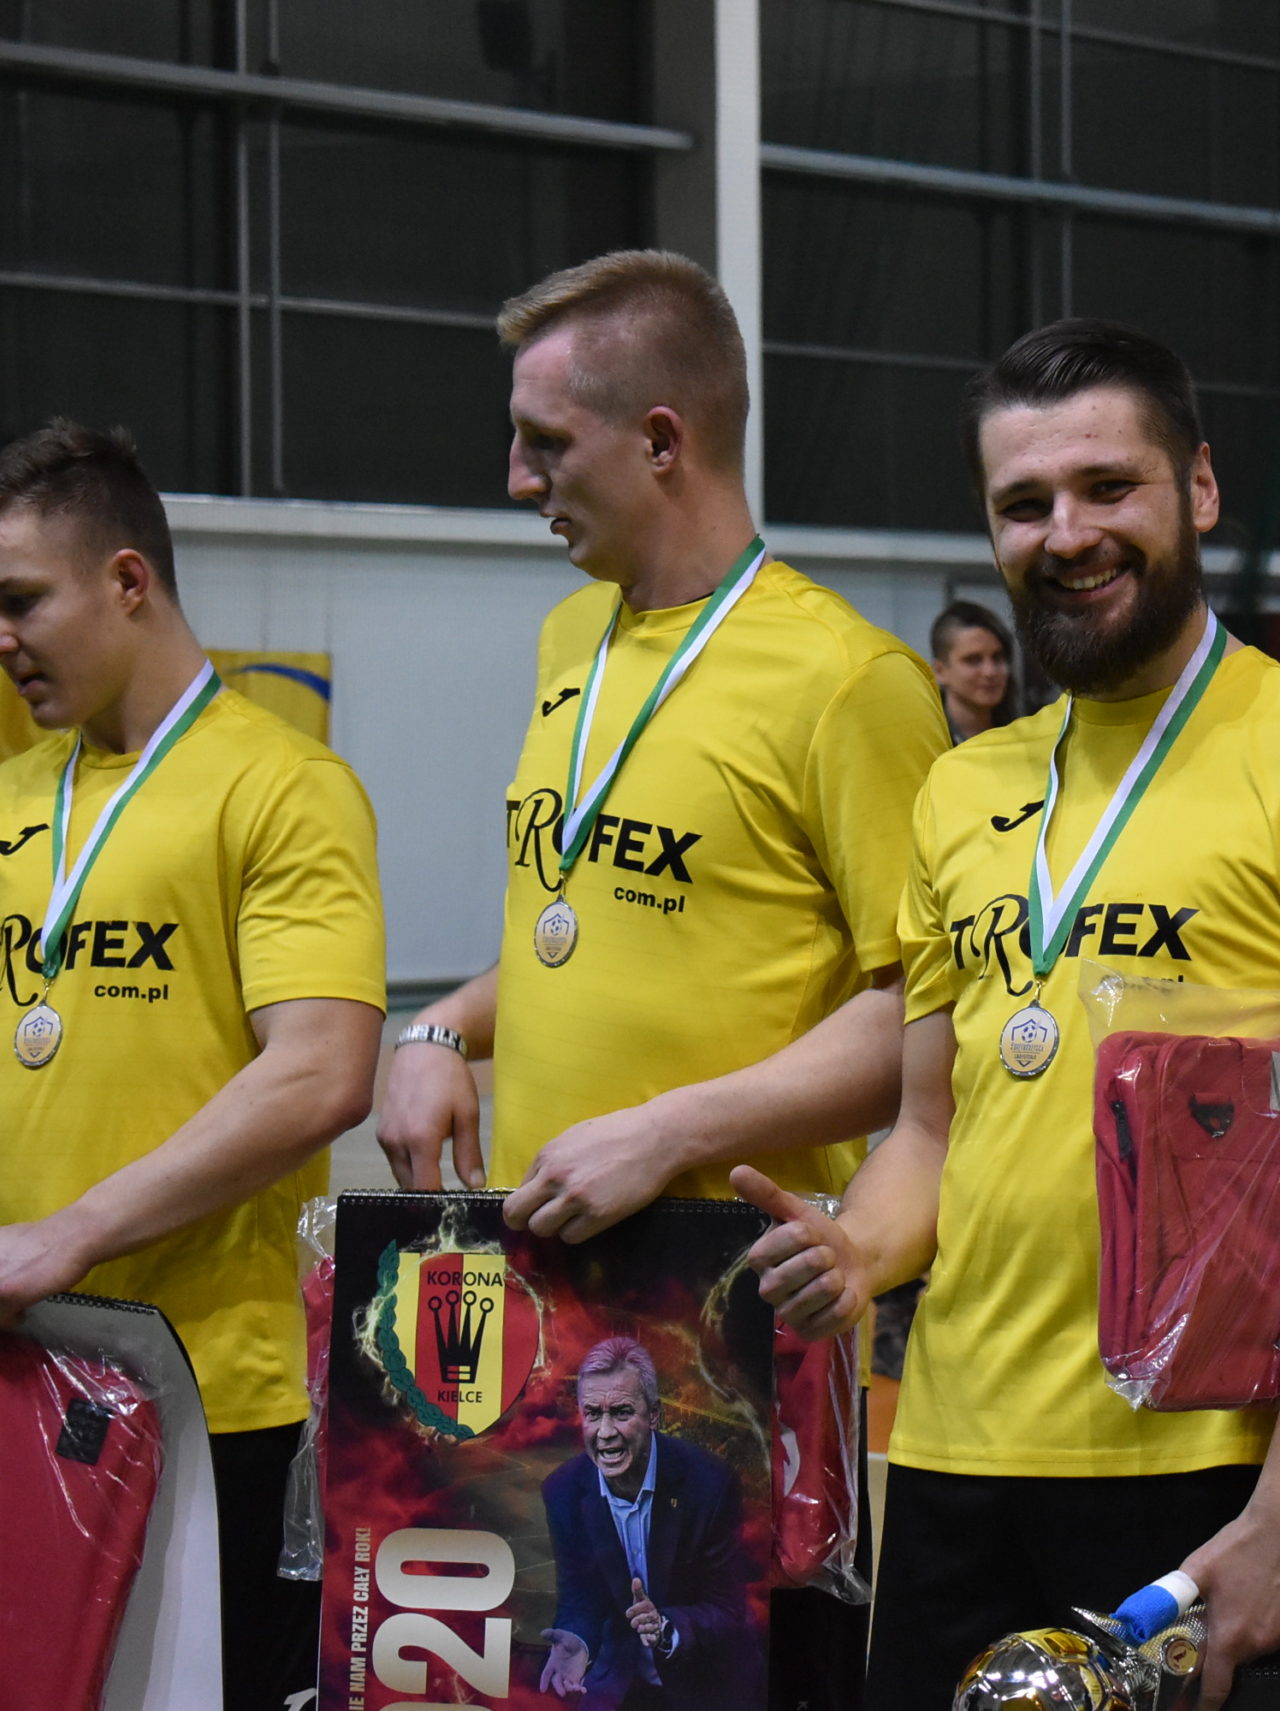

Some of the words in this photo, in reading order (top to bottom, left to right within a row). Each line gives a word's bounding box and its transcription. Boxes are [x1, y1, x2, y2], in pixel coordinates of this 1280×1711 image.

[614, 886, 686, 915] com.pl
[94, 984, 169, 1003] com.pl
[427, 1271, 503, 1287] KORONA
[437, 1390, 483, 1403] KIELCE
[355, 1527, 371, 1562] ROK!
[353, 1566, 371, 1601] CAŁY
[351, 1606, 369, 1652] PRZEZ
[372, 1528, 515, 1711] 20
[349, 1657, 366, 1693] NAM
